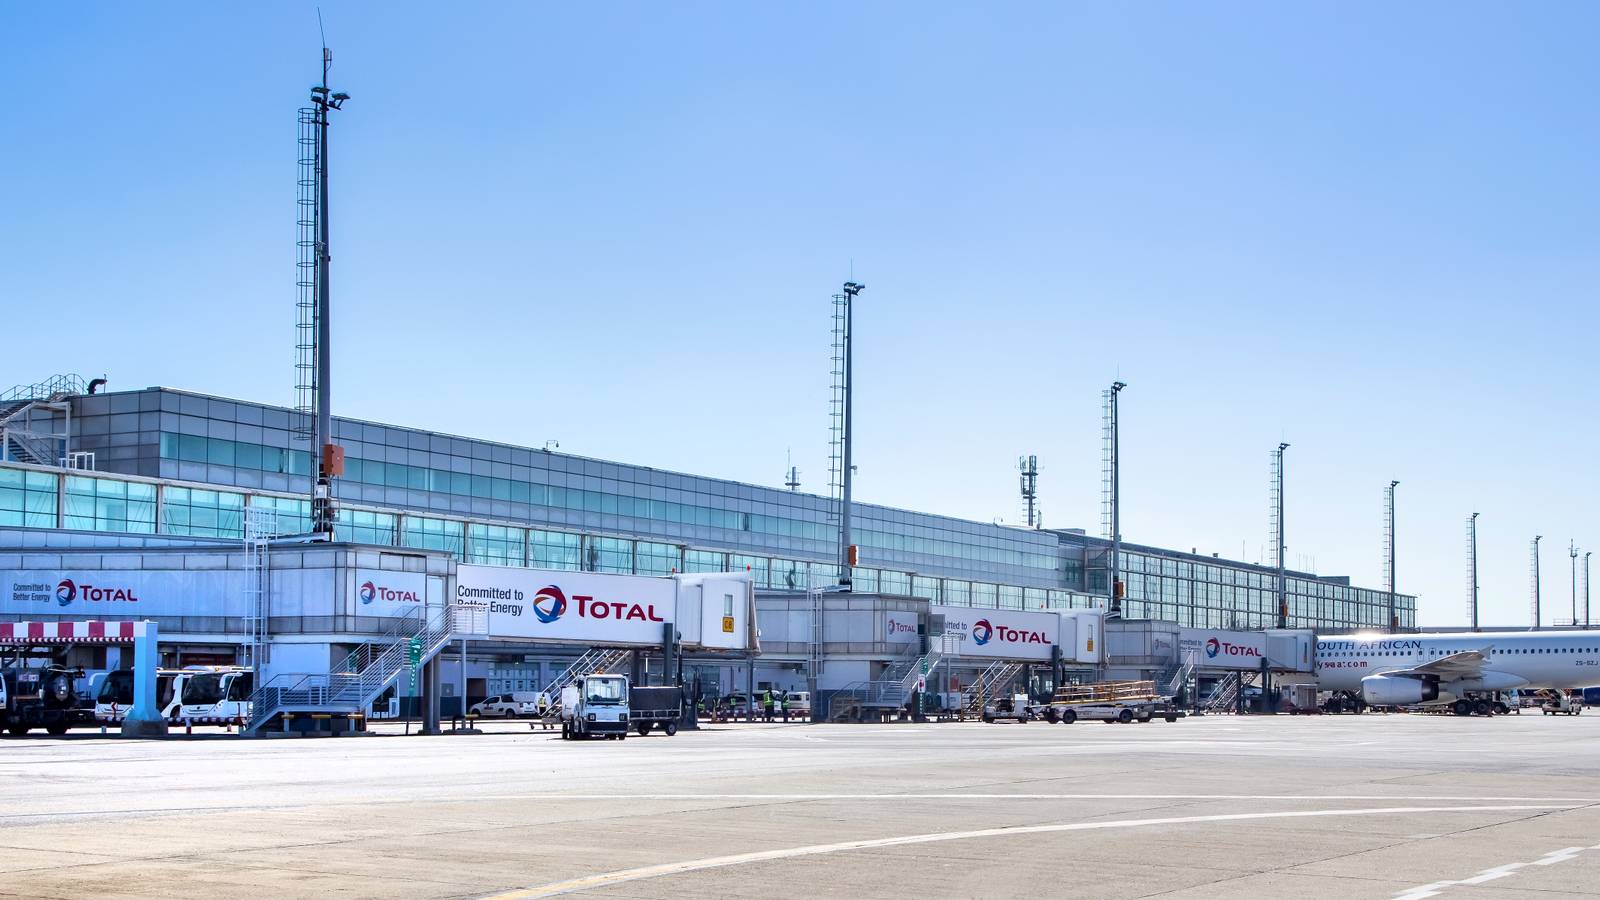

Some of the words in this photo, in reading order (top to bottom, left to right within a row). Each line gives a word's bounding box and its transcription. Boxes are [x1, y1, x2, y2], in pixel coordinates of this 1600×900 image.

[13, 584, 44, 592] Committed
[45, 584, 51, 592] to
[79, 585, 138, 602] TOTAL
[377, 587, 420, 602] TOTAL
[457, 585, 511, 600] Committed
[514, 589, 524, 601] to
[13, 592, 30, 601] Better
[31, 592, 51, 603] Energy
[490, 601, 523, 617] Energy
[572, 595, 664, 622] TOTAL
[895, 622, 916, 633] TOTAL
[961, 621, 968, 630] to
[996, 625, 1052, 644] TOTAL
[1221, 642, 1262, 657] TOTAL
[1316, 641, 1354, 651] OUTH
[1359, 640, 1422, 650] AFRICAN
[1314, 660, 1368, 670] lysaa.com
